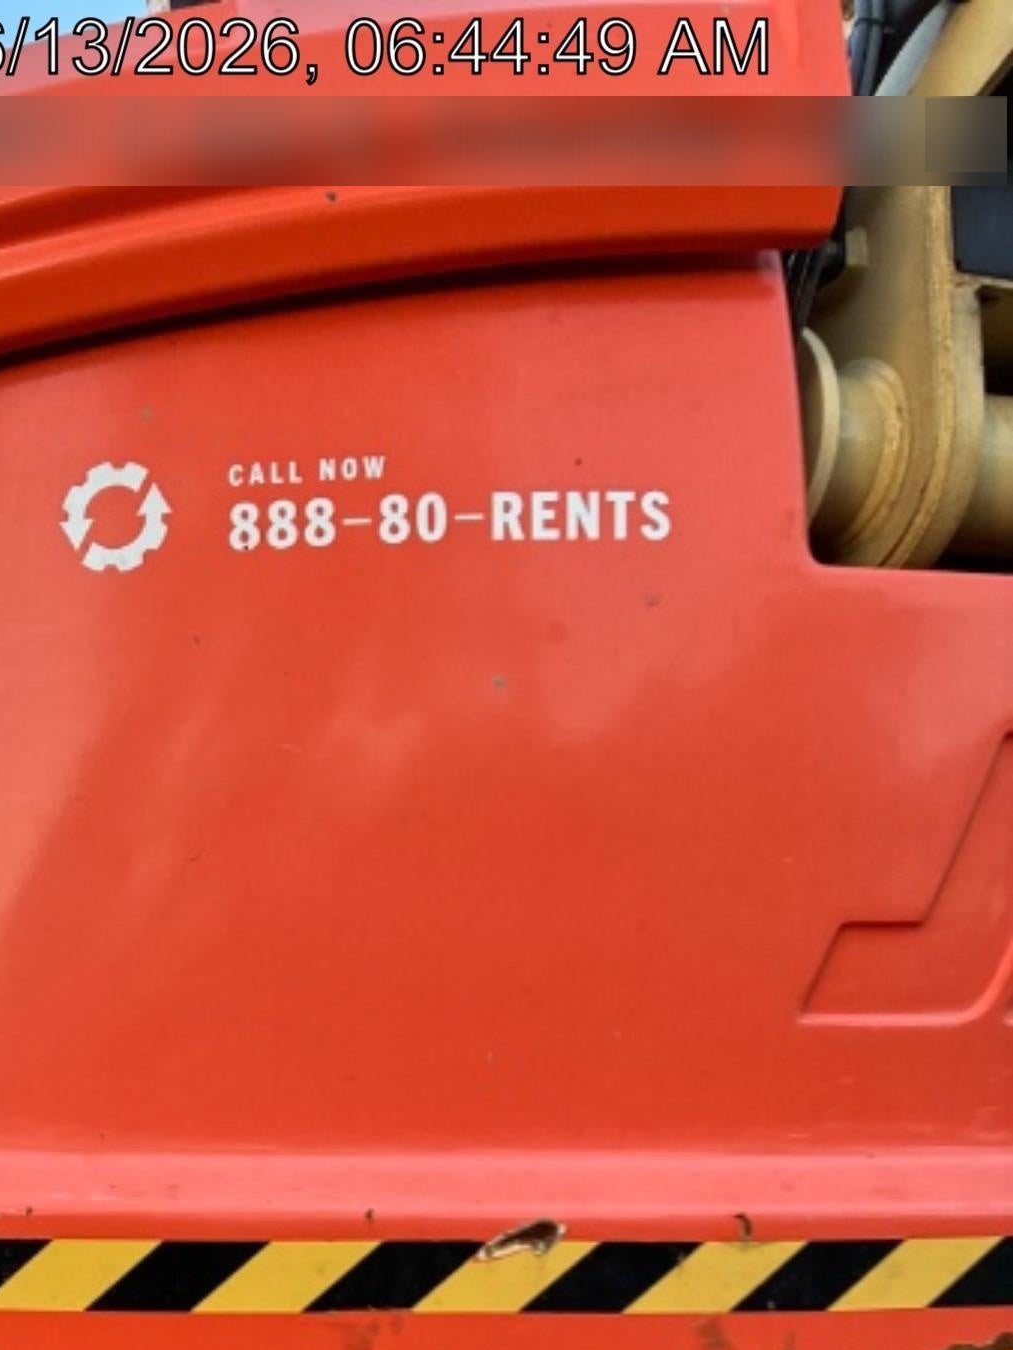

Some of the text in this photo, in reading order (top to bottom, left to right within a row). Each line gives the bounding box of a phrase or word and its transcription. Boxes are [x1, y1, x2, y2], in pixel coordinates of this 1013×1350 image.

[228, 457, 386, 487] CALL NOW
[228, 490, 673, 551] 888-80-RENTS
